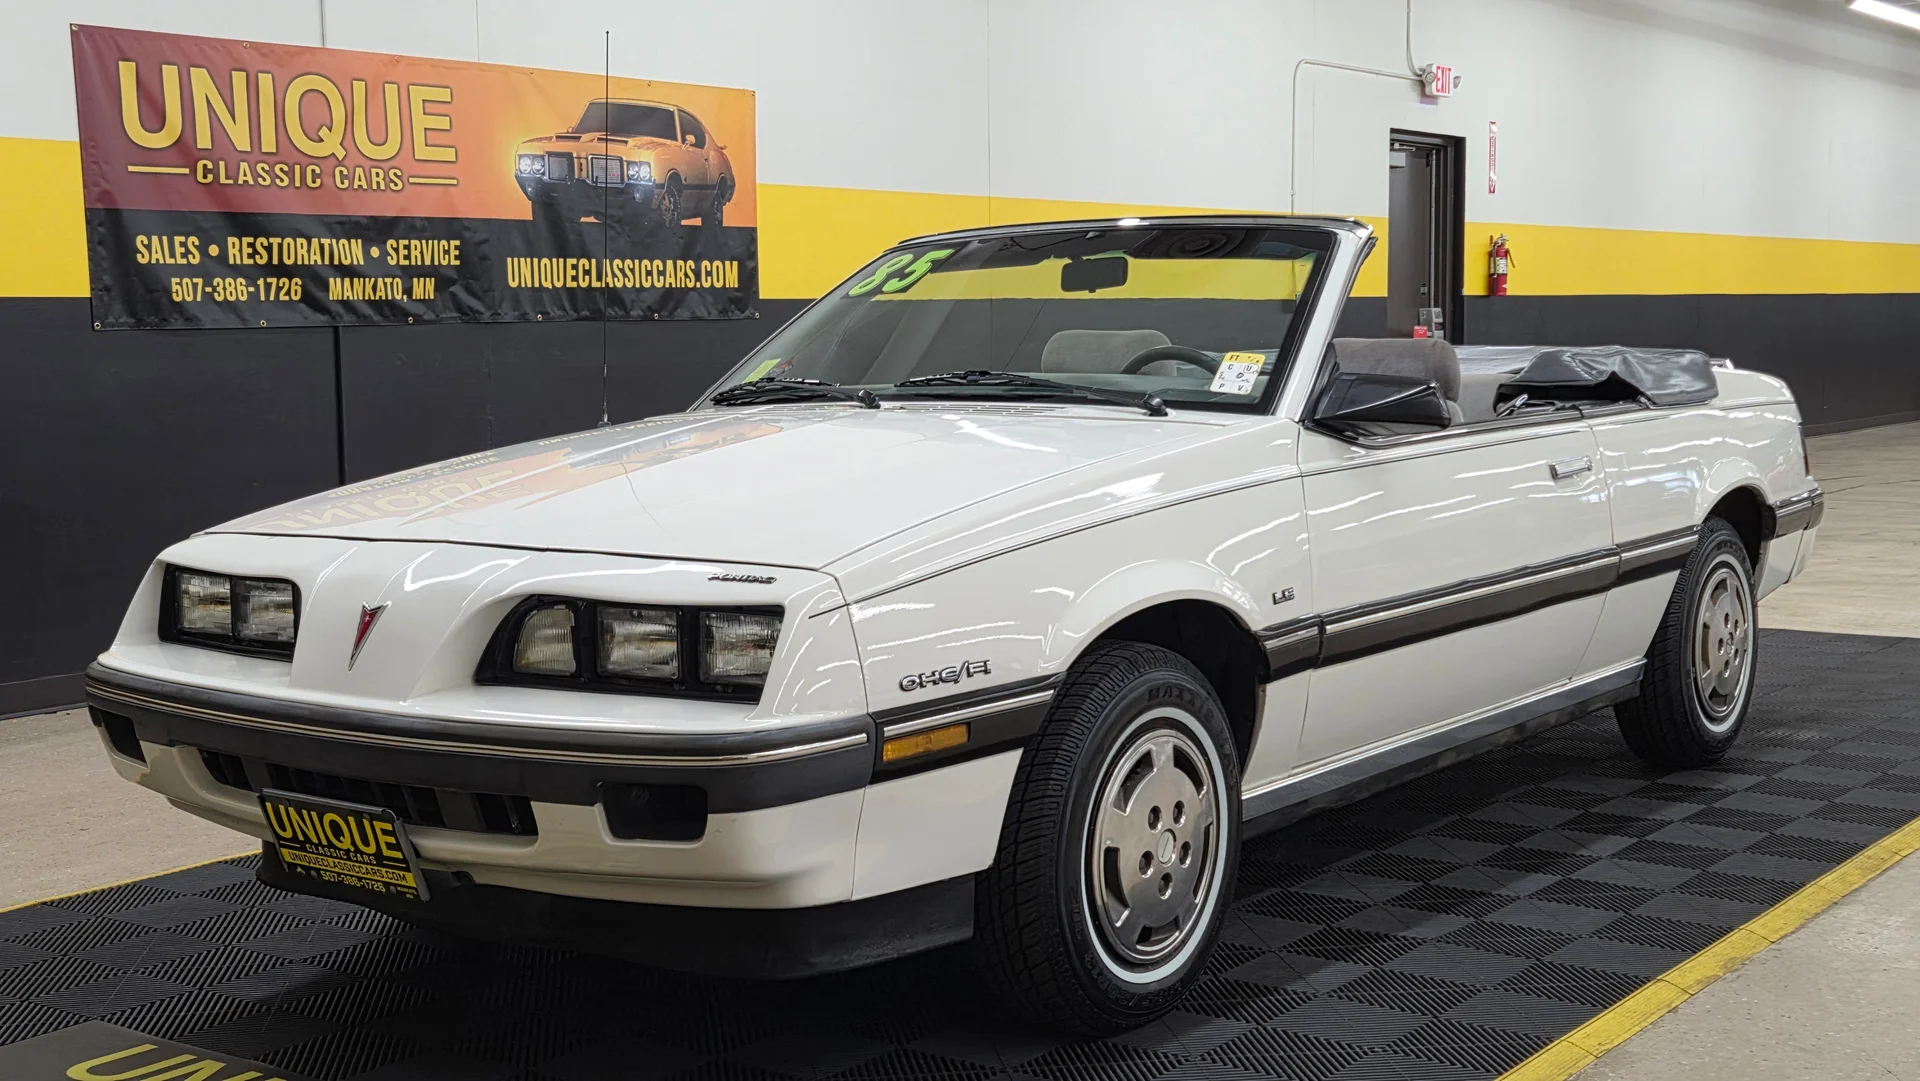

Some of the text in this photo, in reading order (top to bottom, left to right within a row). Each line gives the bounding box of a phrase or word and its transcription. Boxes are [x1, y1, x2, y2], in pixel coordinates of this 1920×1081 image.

[1436, 66, 1452, 94] EXIT
[118, 61, 456, 162] UNIQUE
[196, 160, 403, 191] CLASSIC CARS
[136, 235, 460, 266] SALES RESTORATION SERVICE
[507, 257, 739, 289] UNIQUECLASSICCARS.COM
[848, 249, 955, 296] 85
[171, 277, 435, 302] 507-386-1726 MANKATO, MN
[708, 572, 777, 584] PONTIAC
[1272, 587, 1295, 605] LE
[265, 801, 404, 859] UNIQUE
[288, 850, 408, 884] UNIQUECLASSICCARS.COM
[306, 843, 377, 865] CLASSIC CARS
[320, 870, 386, 893] 507-386-1726
